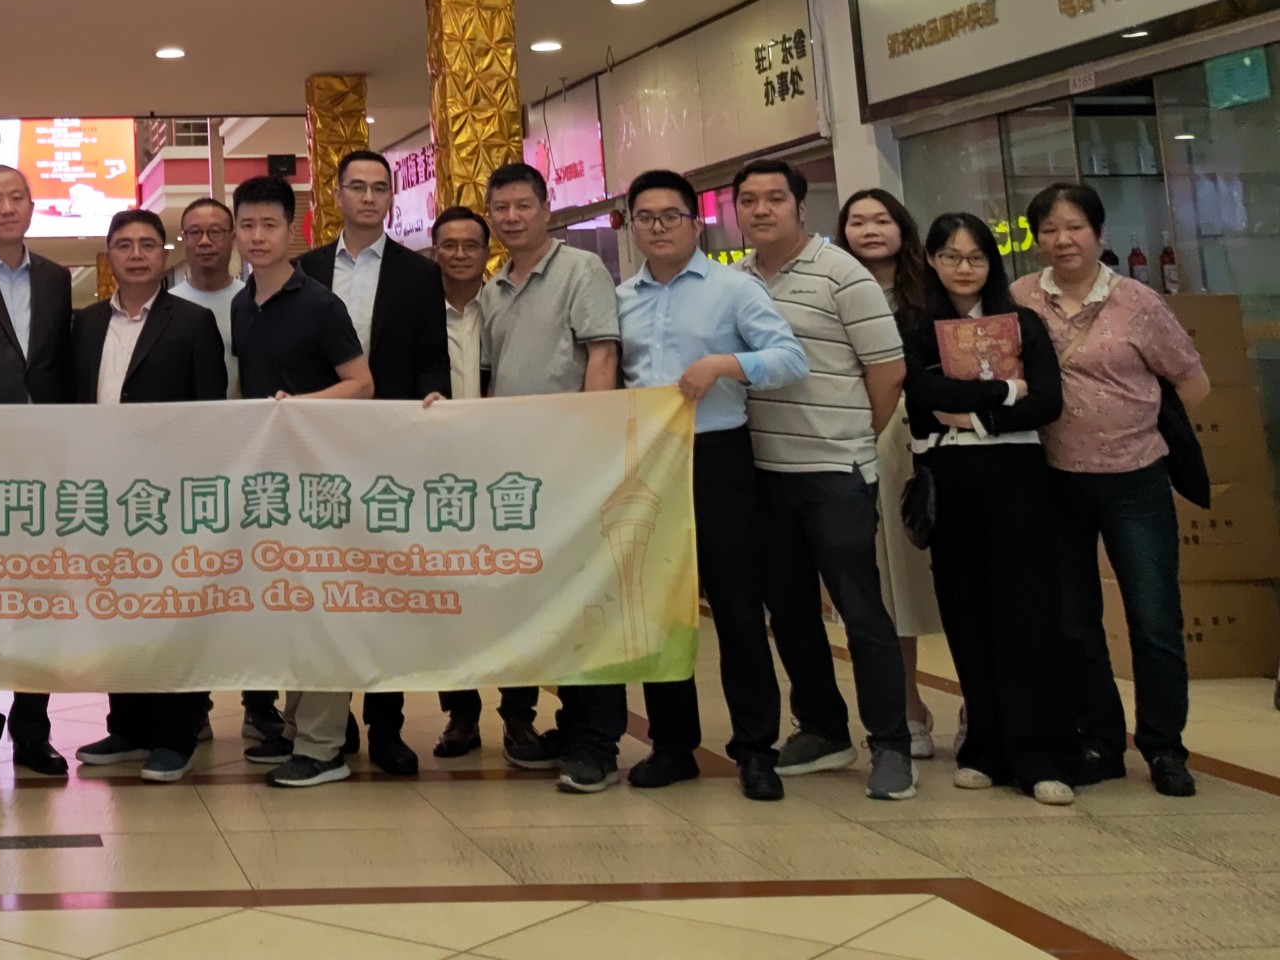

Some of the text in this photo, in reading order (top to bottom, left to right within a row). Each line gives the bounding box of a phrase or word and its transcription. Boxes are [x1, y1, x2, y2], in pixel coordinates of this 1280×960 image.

[763, 65, 805, 107] 办事处
[1072, 73, 1094, 89] A165
[172, 545, 243, 579] dos
[251, 539, 544, 577] Comerciantes
[85, 581, 255, 620] Cozinha
[261, 578, 315, 612] de
[322, 580, 462, 615] Macau
